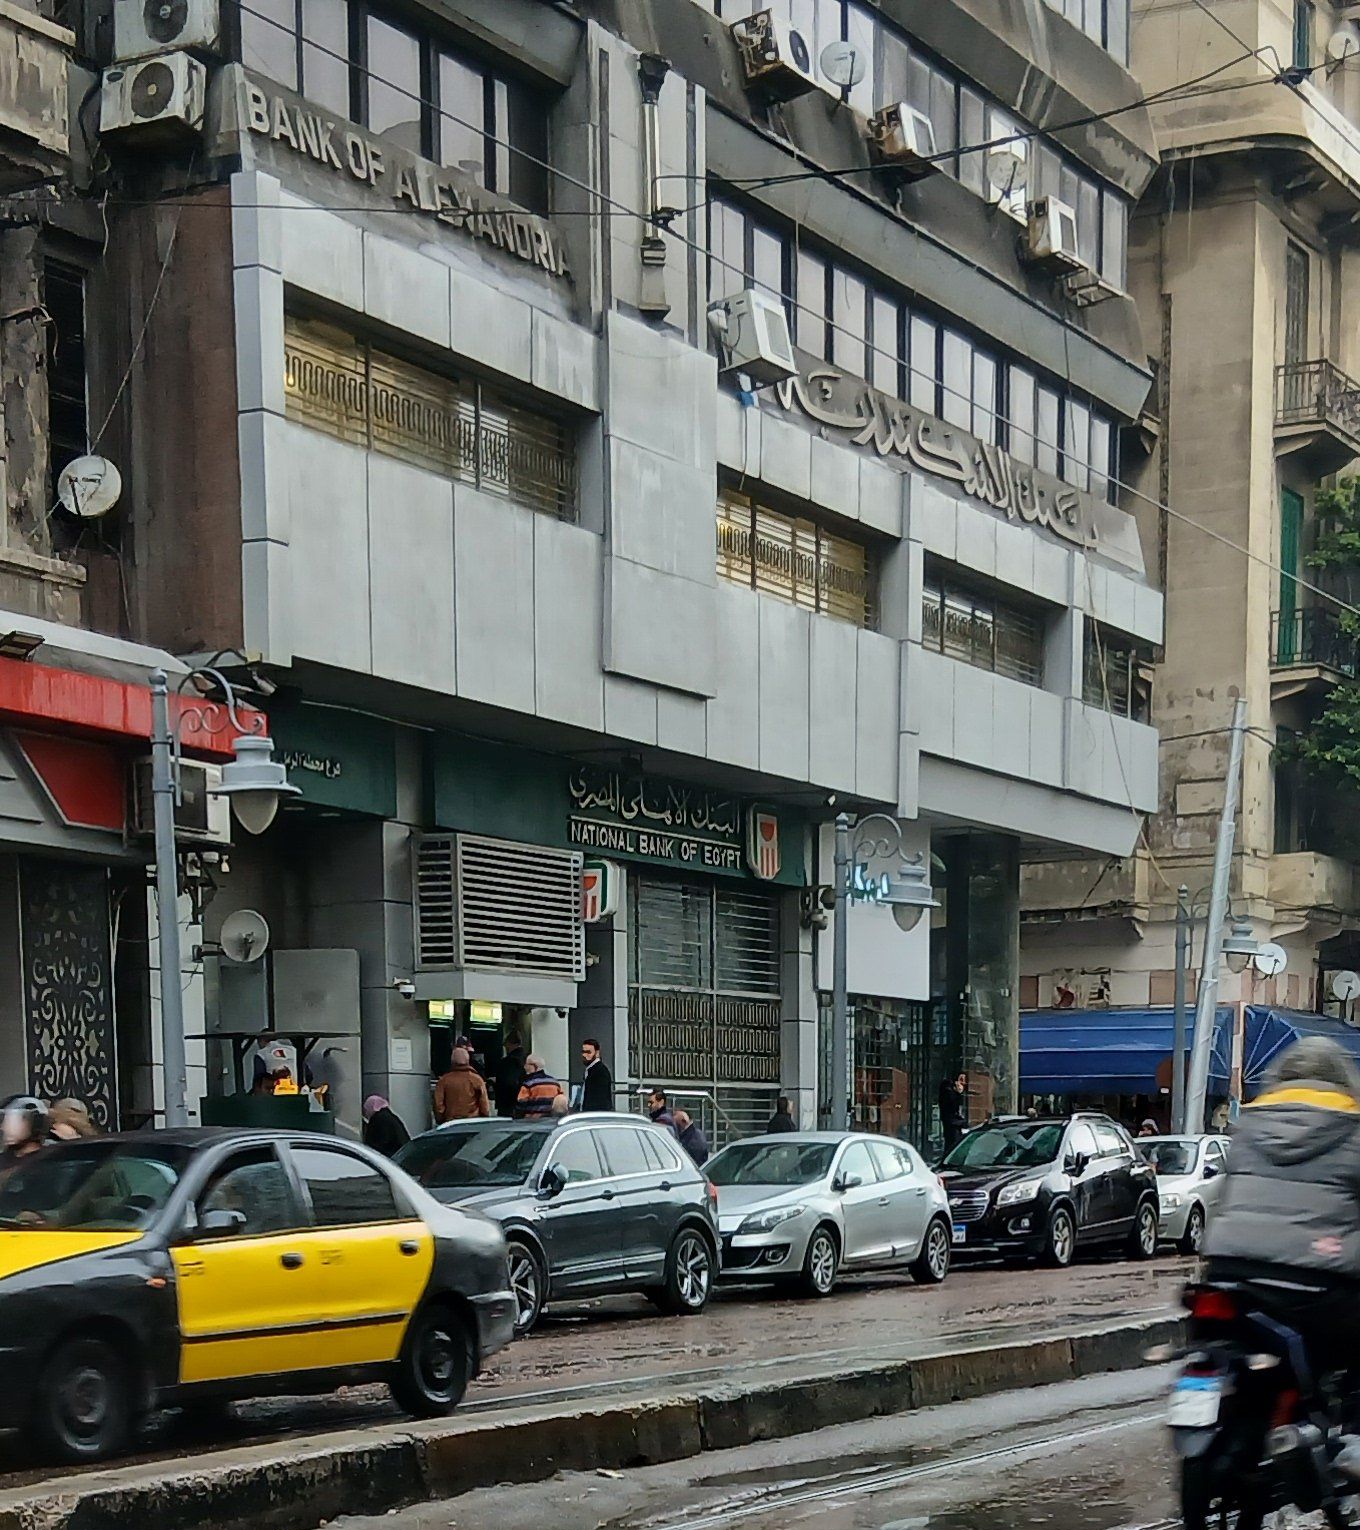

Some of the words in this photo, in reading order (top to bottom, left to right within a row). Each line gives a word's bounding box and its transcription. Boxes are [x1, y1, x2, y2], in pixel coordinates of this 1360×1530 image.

[244, 79, 343, 171] BANK
[345, 131, 386, 186] OF
[570, 821, 635, 852] NATIONAL
[639, 834, 674, 859] BANK
[680, 841, 698, 861] OF
[703, 845, 741, 870] EGYPT
